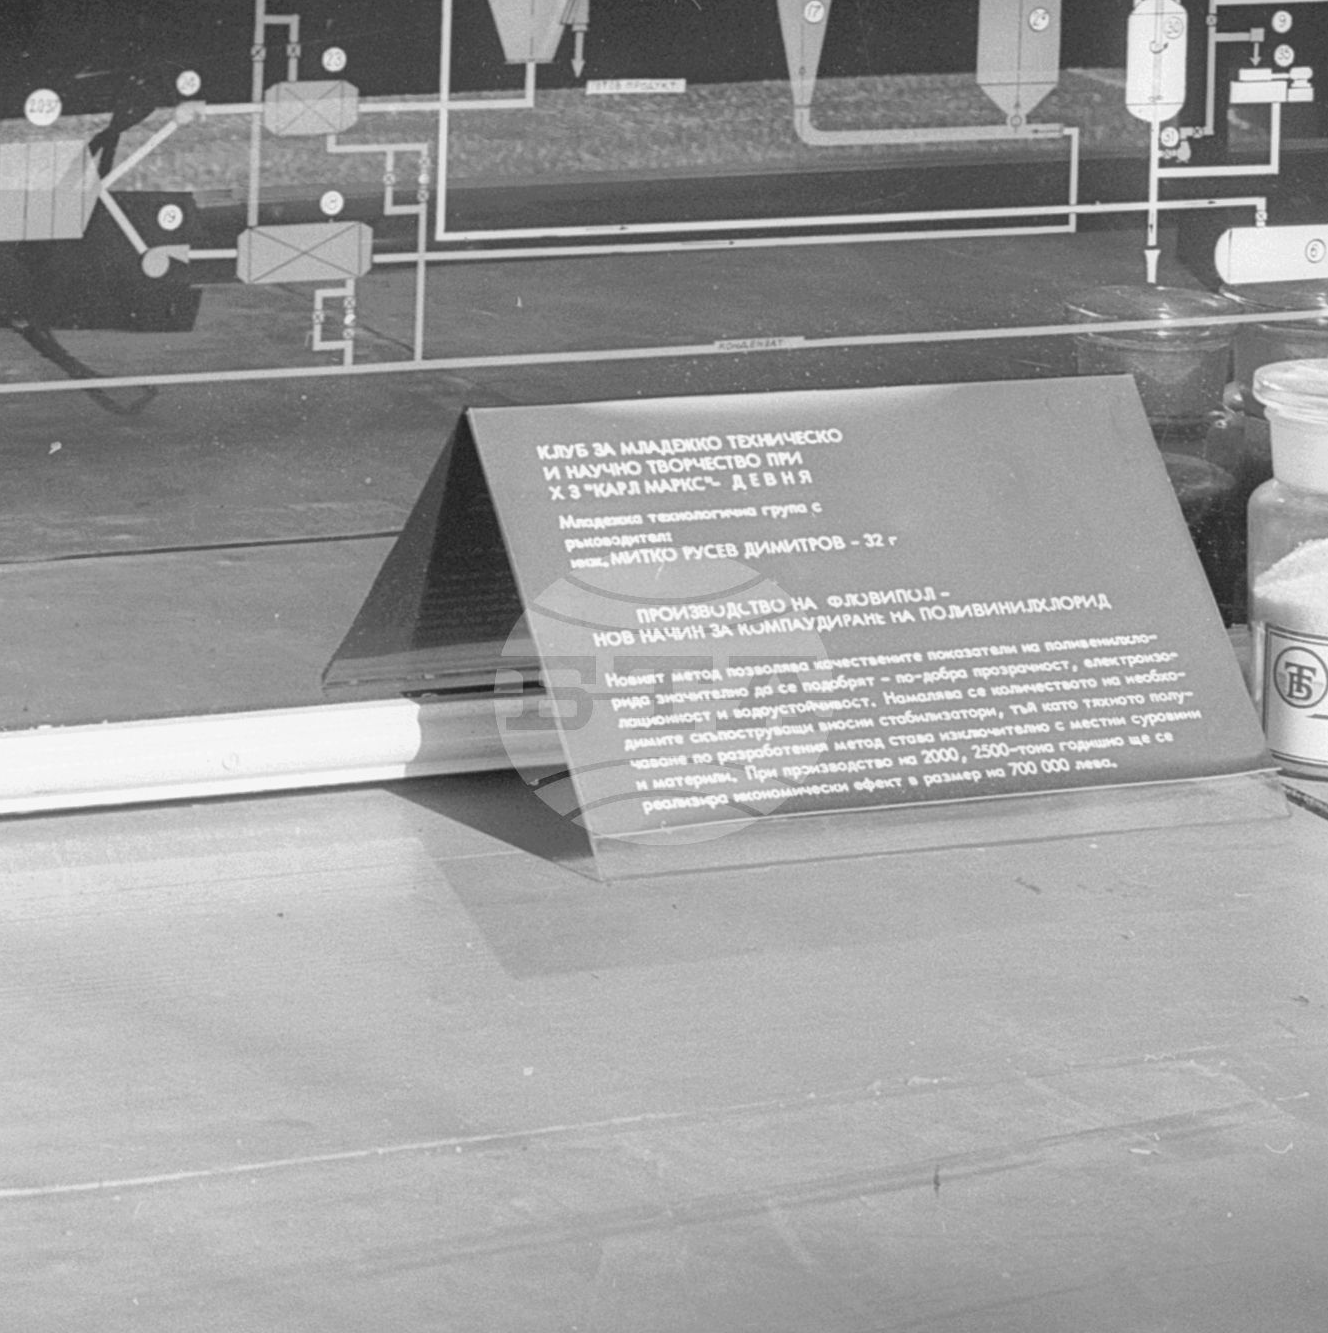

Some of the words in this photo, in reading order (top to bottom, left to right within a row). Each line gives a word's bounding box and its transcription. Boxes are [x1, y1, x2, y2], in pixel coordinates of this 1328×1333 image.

[536, 443, 589, 460] КЛУБ
[591, 442, 617, 457] ЗА
[620, 435, 722, 456] МЛАДЕЖКО
[726, 428, 843, 449] ТЕХНИЧЕСКО
[543, 466, 561, 481] И
[565, 460, 642, 480] НАУЧНО
[646, 453, 762, 474] ТВОРЧЕСТВО
[765, 451, 803, 467] ПРИ
[559, 514, 643, 530] Младежка
[647, 506, 758, 523] технологична
[761, 503, 808, 519] група
[610, 547, 678, 566] МИТКО
[682, 543, 739, 560] РУСЕВ
[744, 535, 846, 559] ДИМИТРОВ
[863, 533, 885, 548] 32
[593, 630, 636, 647] НОВ
[639, 625, 706, 644] НАЧИН
[709, 623, 734, 638] ЗА
[889, 610, 916, 624] НА
[919, 593, 1113, 622] ПОЛИВИНИЛХЛОРИД
[636, 598, 786, 624] ПРОИЗВОДСТВО
[790, 596, 818, 612] НА
[826, 586, 937, 608] ФЛОВИПОЛ
[672, 669, 723, 683] метод
[726, 661, 809, 678] позволява
[813, 651, 923, 670] качествените
[895, 666, 968, 683] по-добра
[882, 689, 963, 705] Намалява
[990, 677, 1098, 696] количеството
[1130, 710, 1202, 727] суровини
[1007, 761, 1038, 776] 700
[1040, 758, 1070, 772] 000
[1075, 757, 1118, 771] лева.
